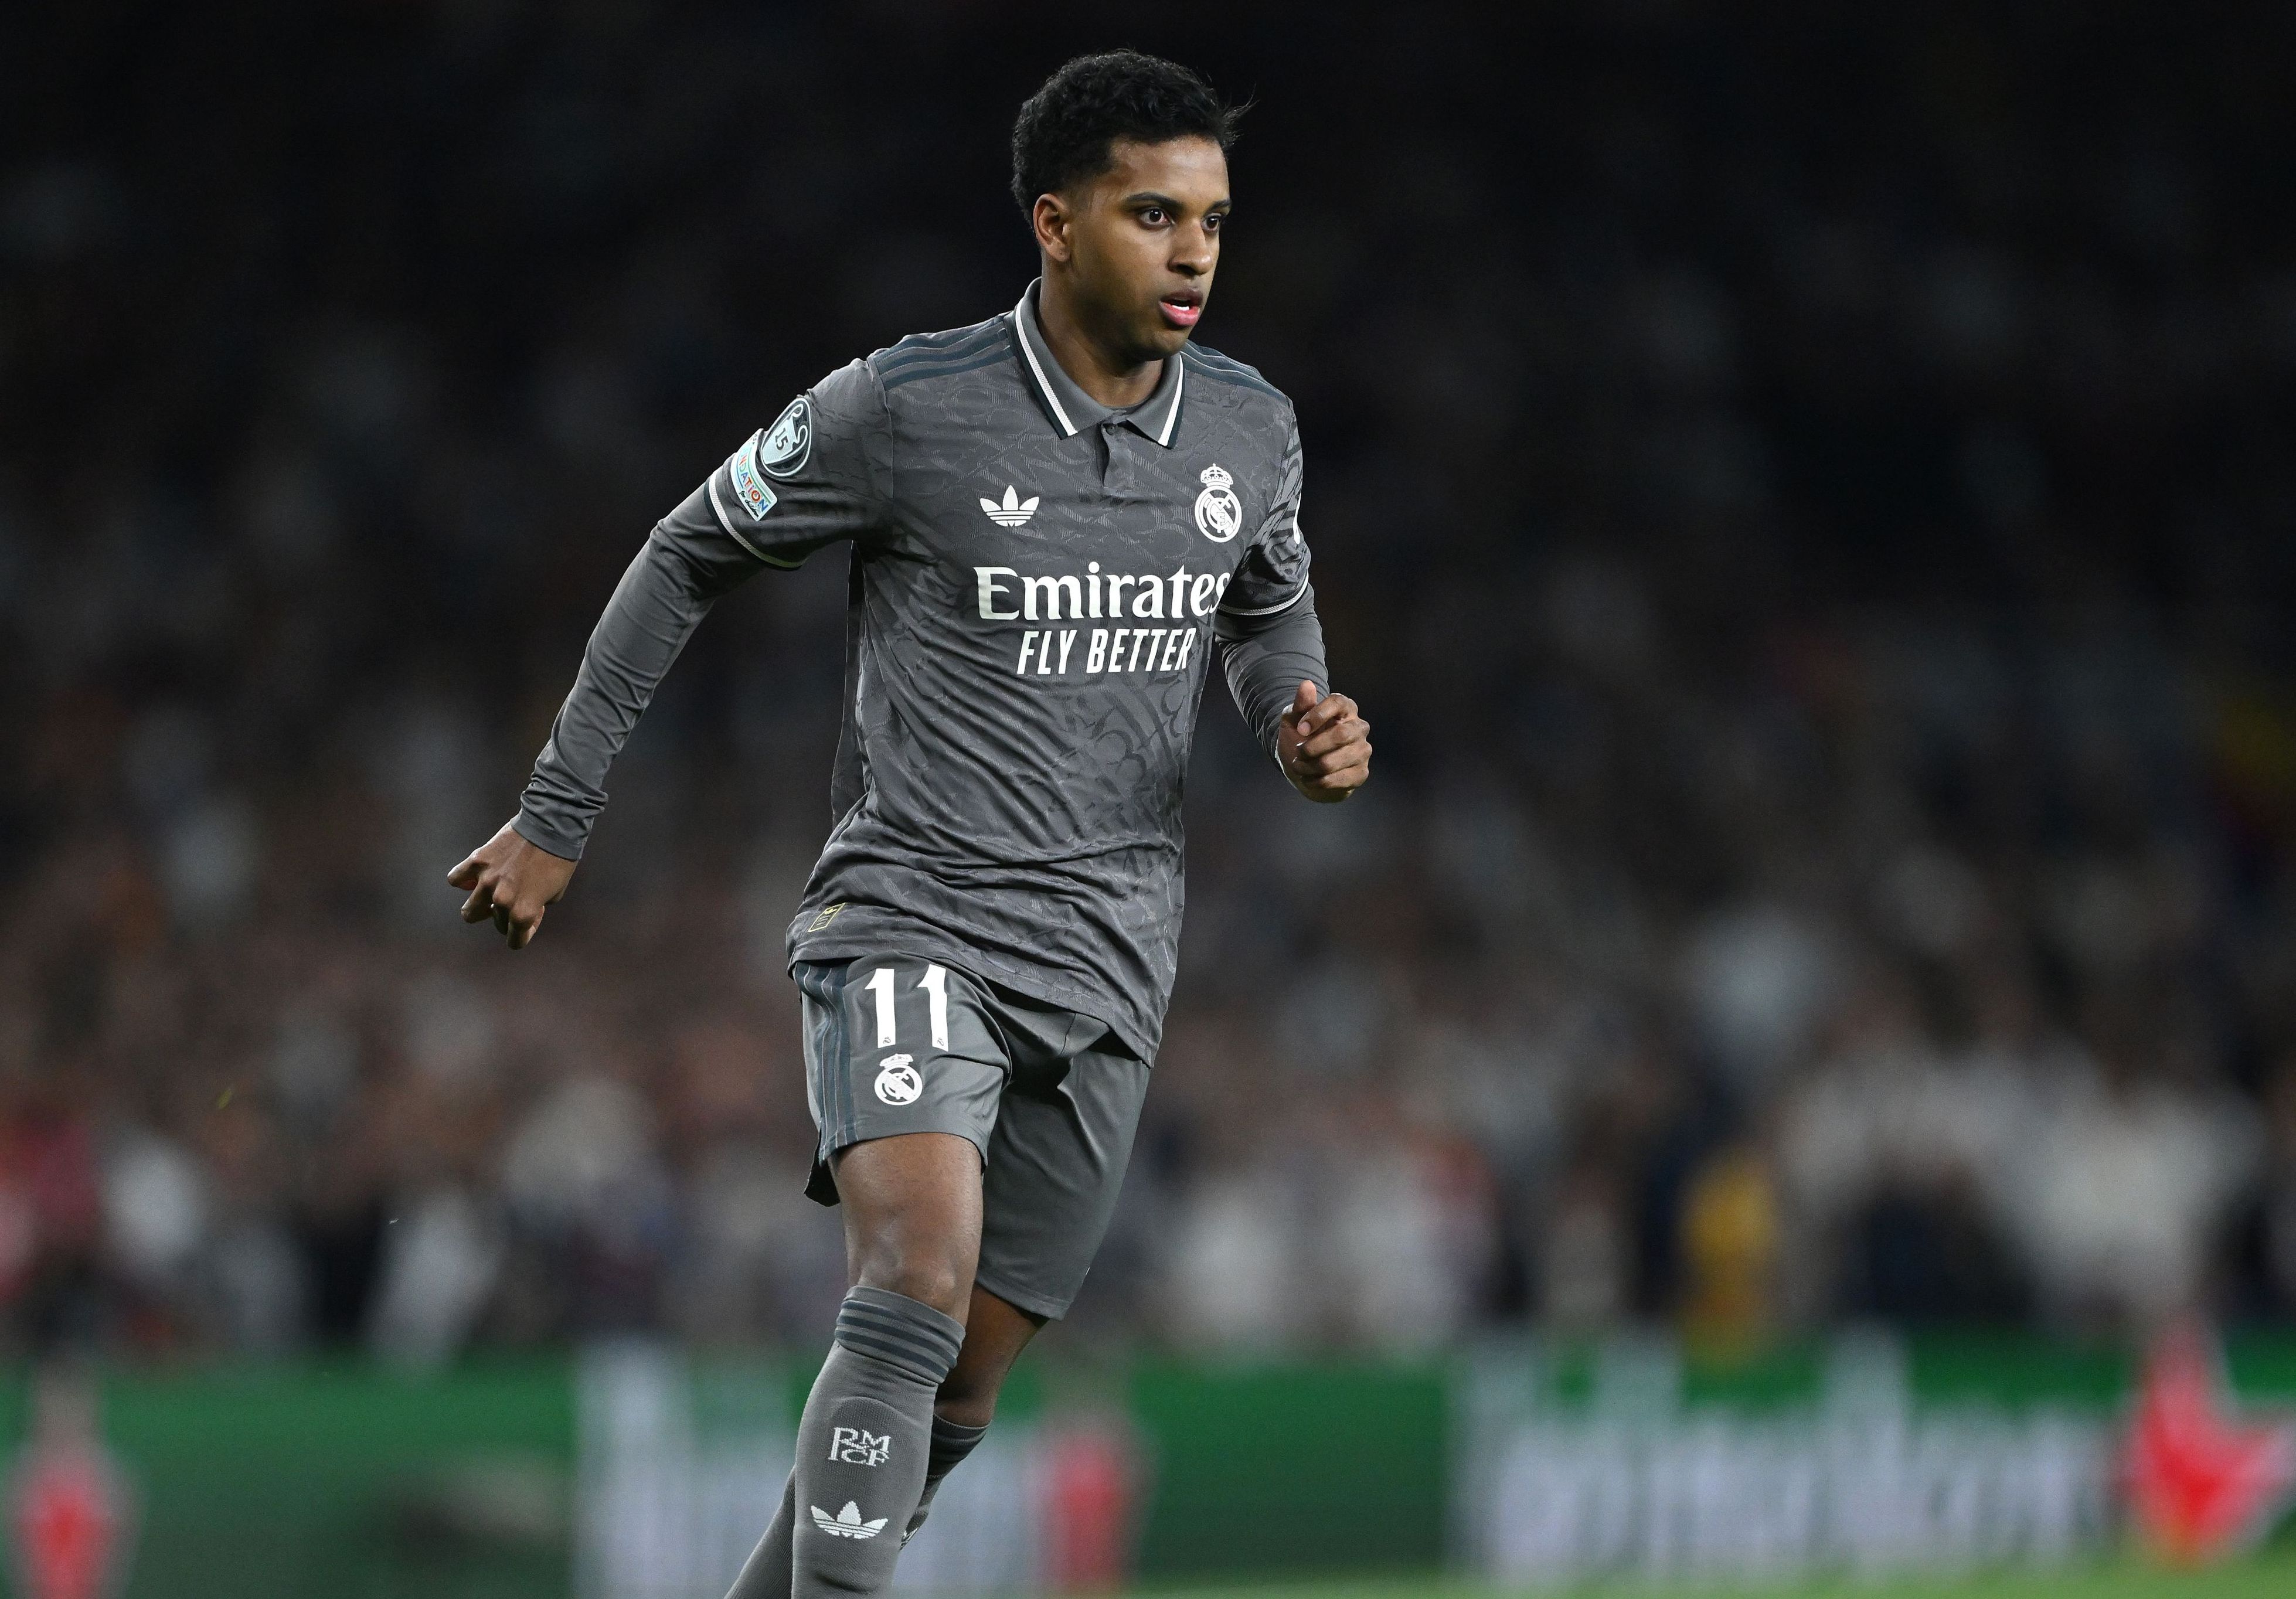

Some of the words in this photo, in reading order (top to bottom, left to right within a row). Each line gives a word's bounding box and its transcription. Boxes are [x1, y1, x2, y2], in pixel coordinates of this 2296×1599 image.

[774, 427, 789, 451] 15
[973, 561, 1231, 620] Emirates
[1016, 630, 1077, 675] FLY
[1086, 627, 1197, 673] BETTER
[865, 964, 949, 1052] 11
